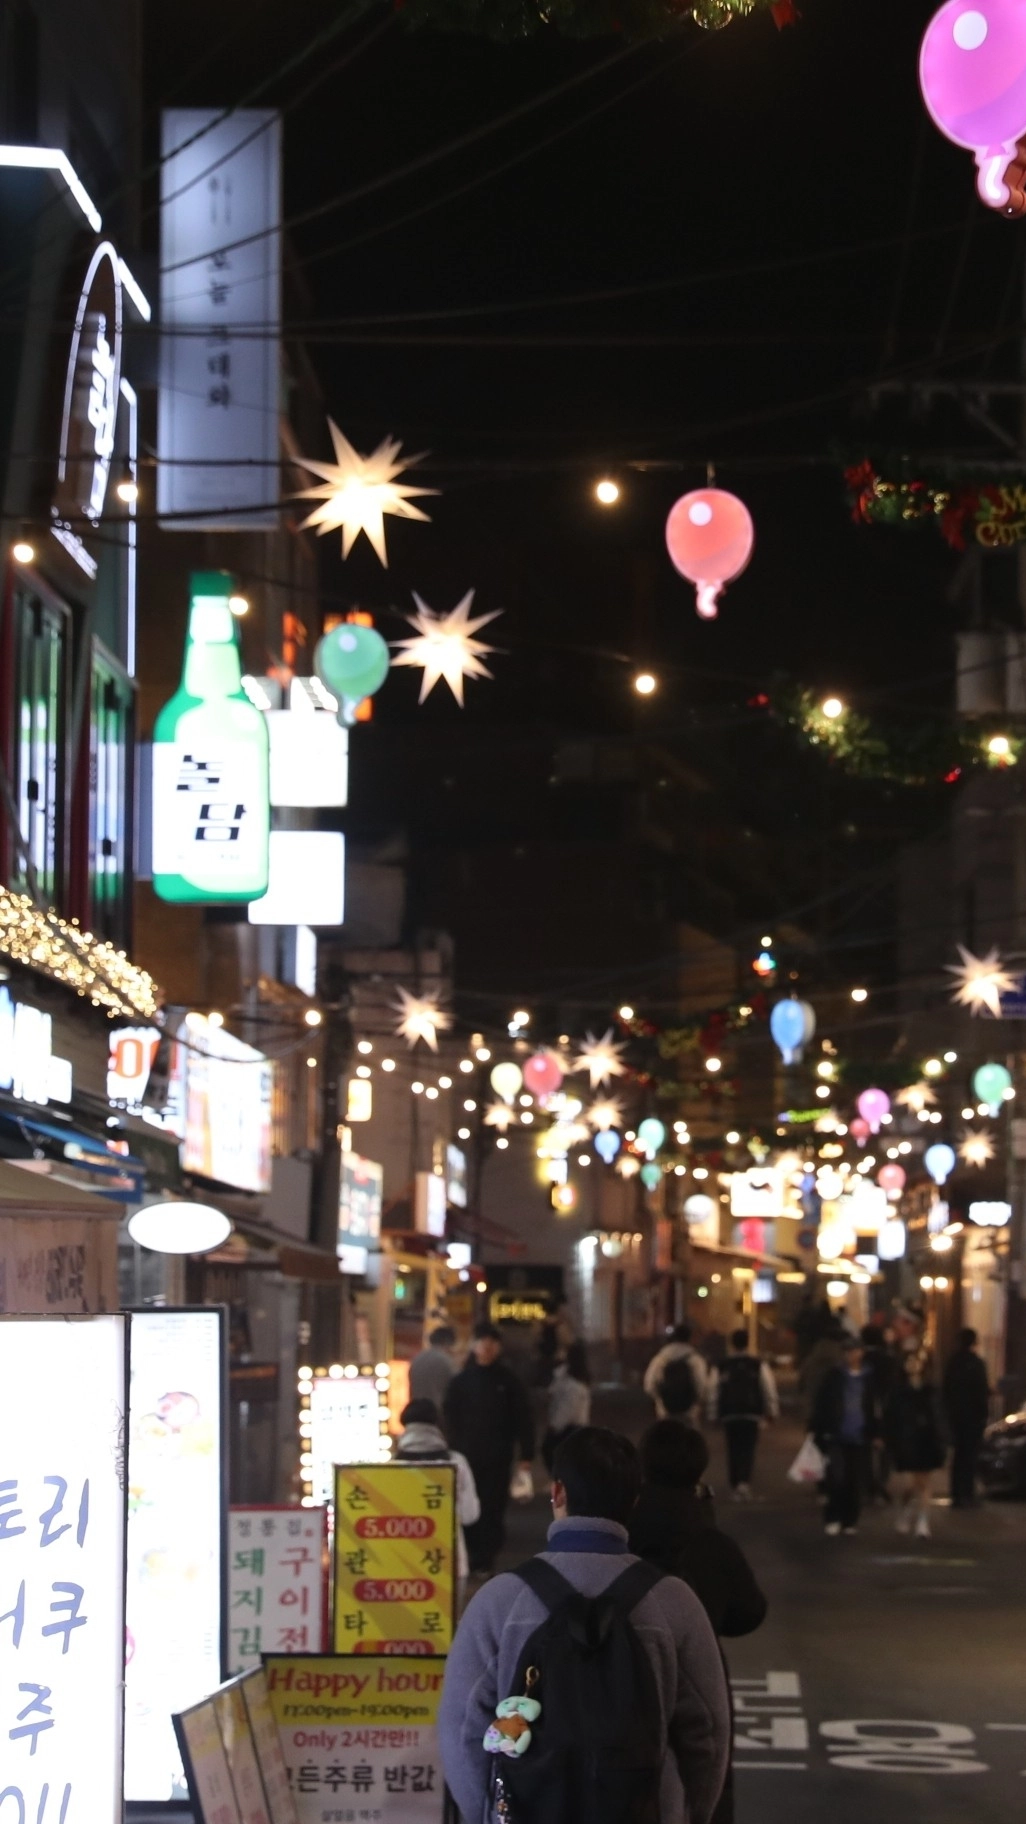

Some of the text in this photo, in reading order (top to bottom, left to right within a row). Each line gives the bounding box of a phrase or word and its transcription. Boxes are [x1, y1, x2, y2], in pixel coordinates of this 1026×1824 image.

[268, 1666, 444, 1698] Happy hour
[293, 1730, 337, 1751] Only
[384, 1764, 437, 1794] 반값
